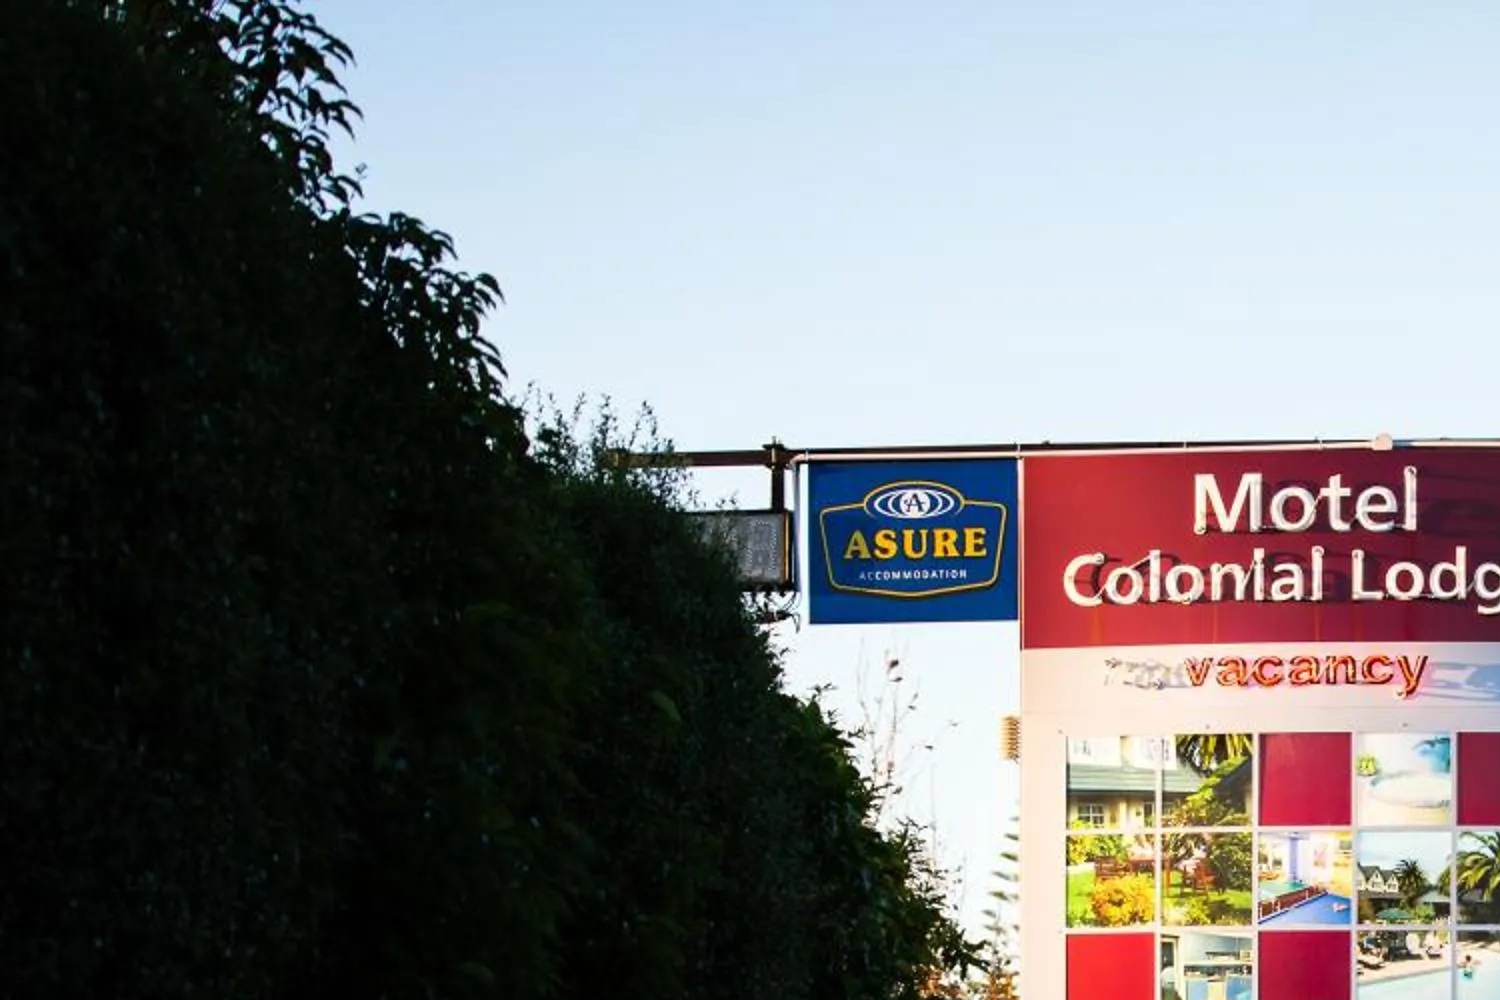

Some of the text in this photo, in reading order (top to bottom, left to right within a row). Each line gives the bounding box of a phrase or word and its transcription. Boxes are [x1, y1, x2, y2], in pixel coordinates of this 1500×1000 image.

[1194, 465, 1418, 535] Motel
[843, 527, 987, 559] ASURE
[859, 568, 968, 580] ACCOMMODATION
[1063, 545, 1325, 607] Colonial
[1184, 654, 1429, 700] vacancy
